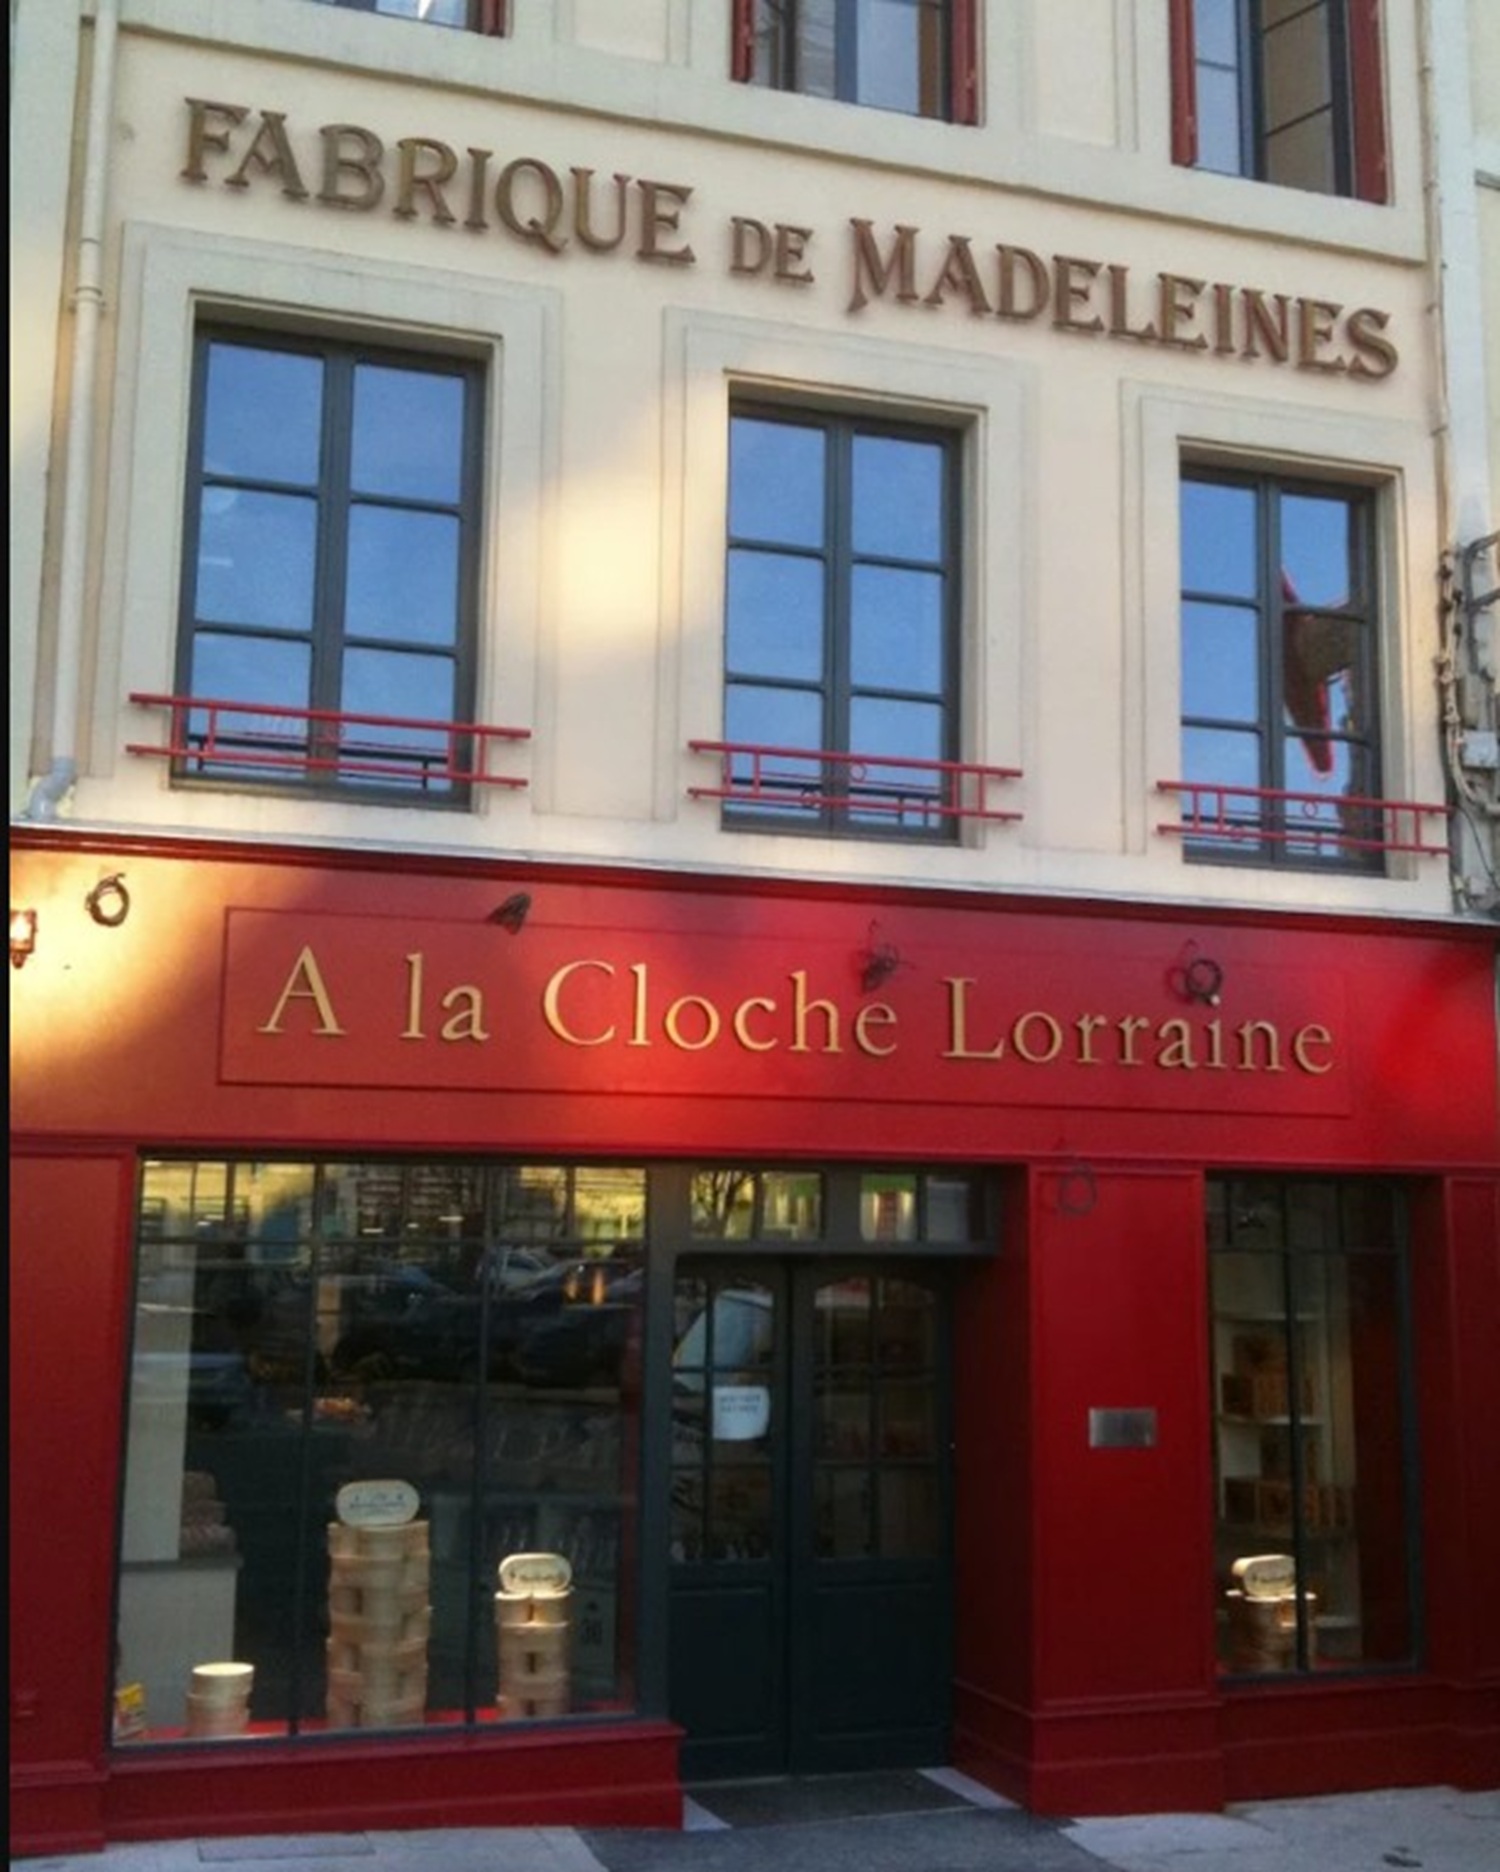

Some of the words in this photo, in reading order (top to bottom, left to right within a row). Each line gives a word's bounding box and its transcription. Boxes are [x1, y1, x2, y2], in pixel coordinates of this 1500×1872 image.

[180, 96, 697, 265] FABRIQUE
[729, 215, 815, 284] DE
[846, 217, 1399, 380] MADELEINES
[257, 945, 347, 1036] A
[399, 952, 490, 1042] la
[542, 959, 898, 1056] Cloche
[943, 977, 1334, 1074] Lorraine
